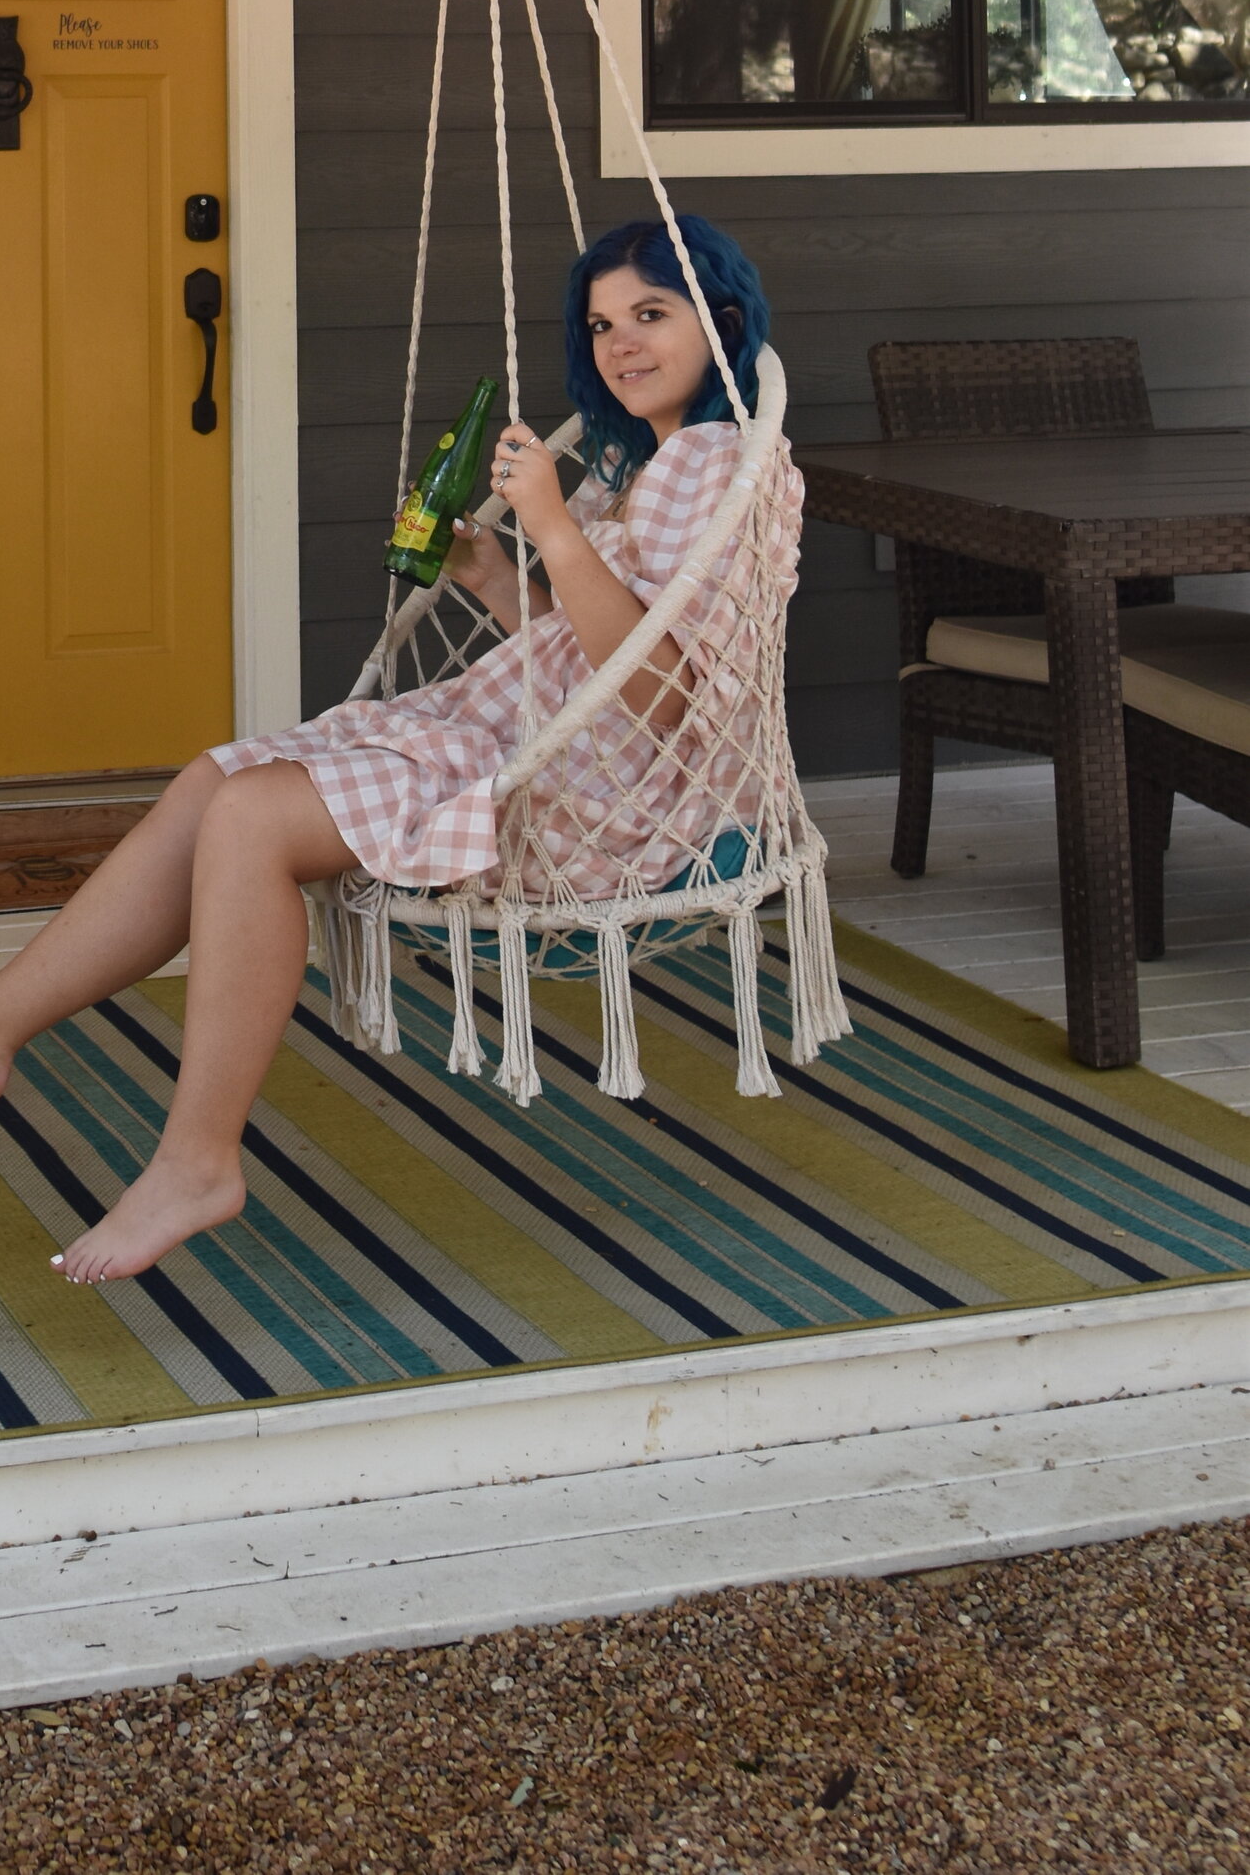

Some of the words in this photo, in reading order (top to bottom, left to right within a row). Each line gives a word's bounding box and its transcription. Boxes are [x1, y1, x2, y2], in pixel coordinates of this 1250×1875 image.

[58, 13, 103, 37] Please
[52, 39, 95, 50] REMOVE
[98, 39, 124, 50] YOUR
[126, 39, 159, 50] SHOES
[404, 515, 429, 533] Chico
